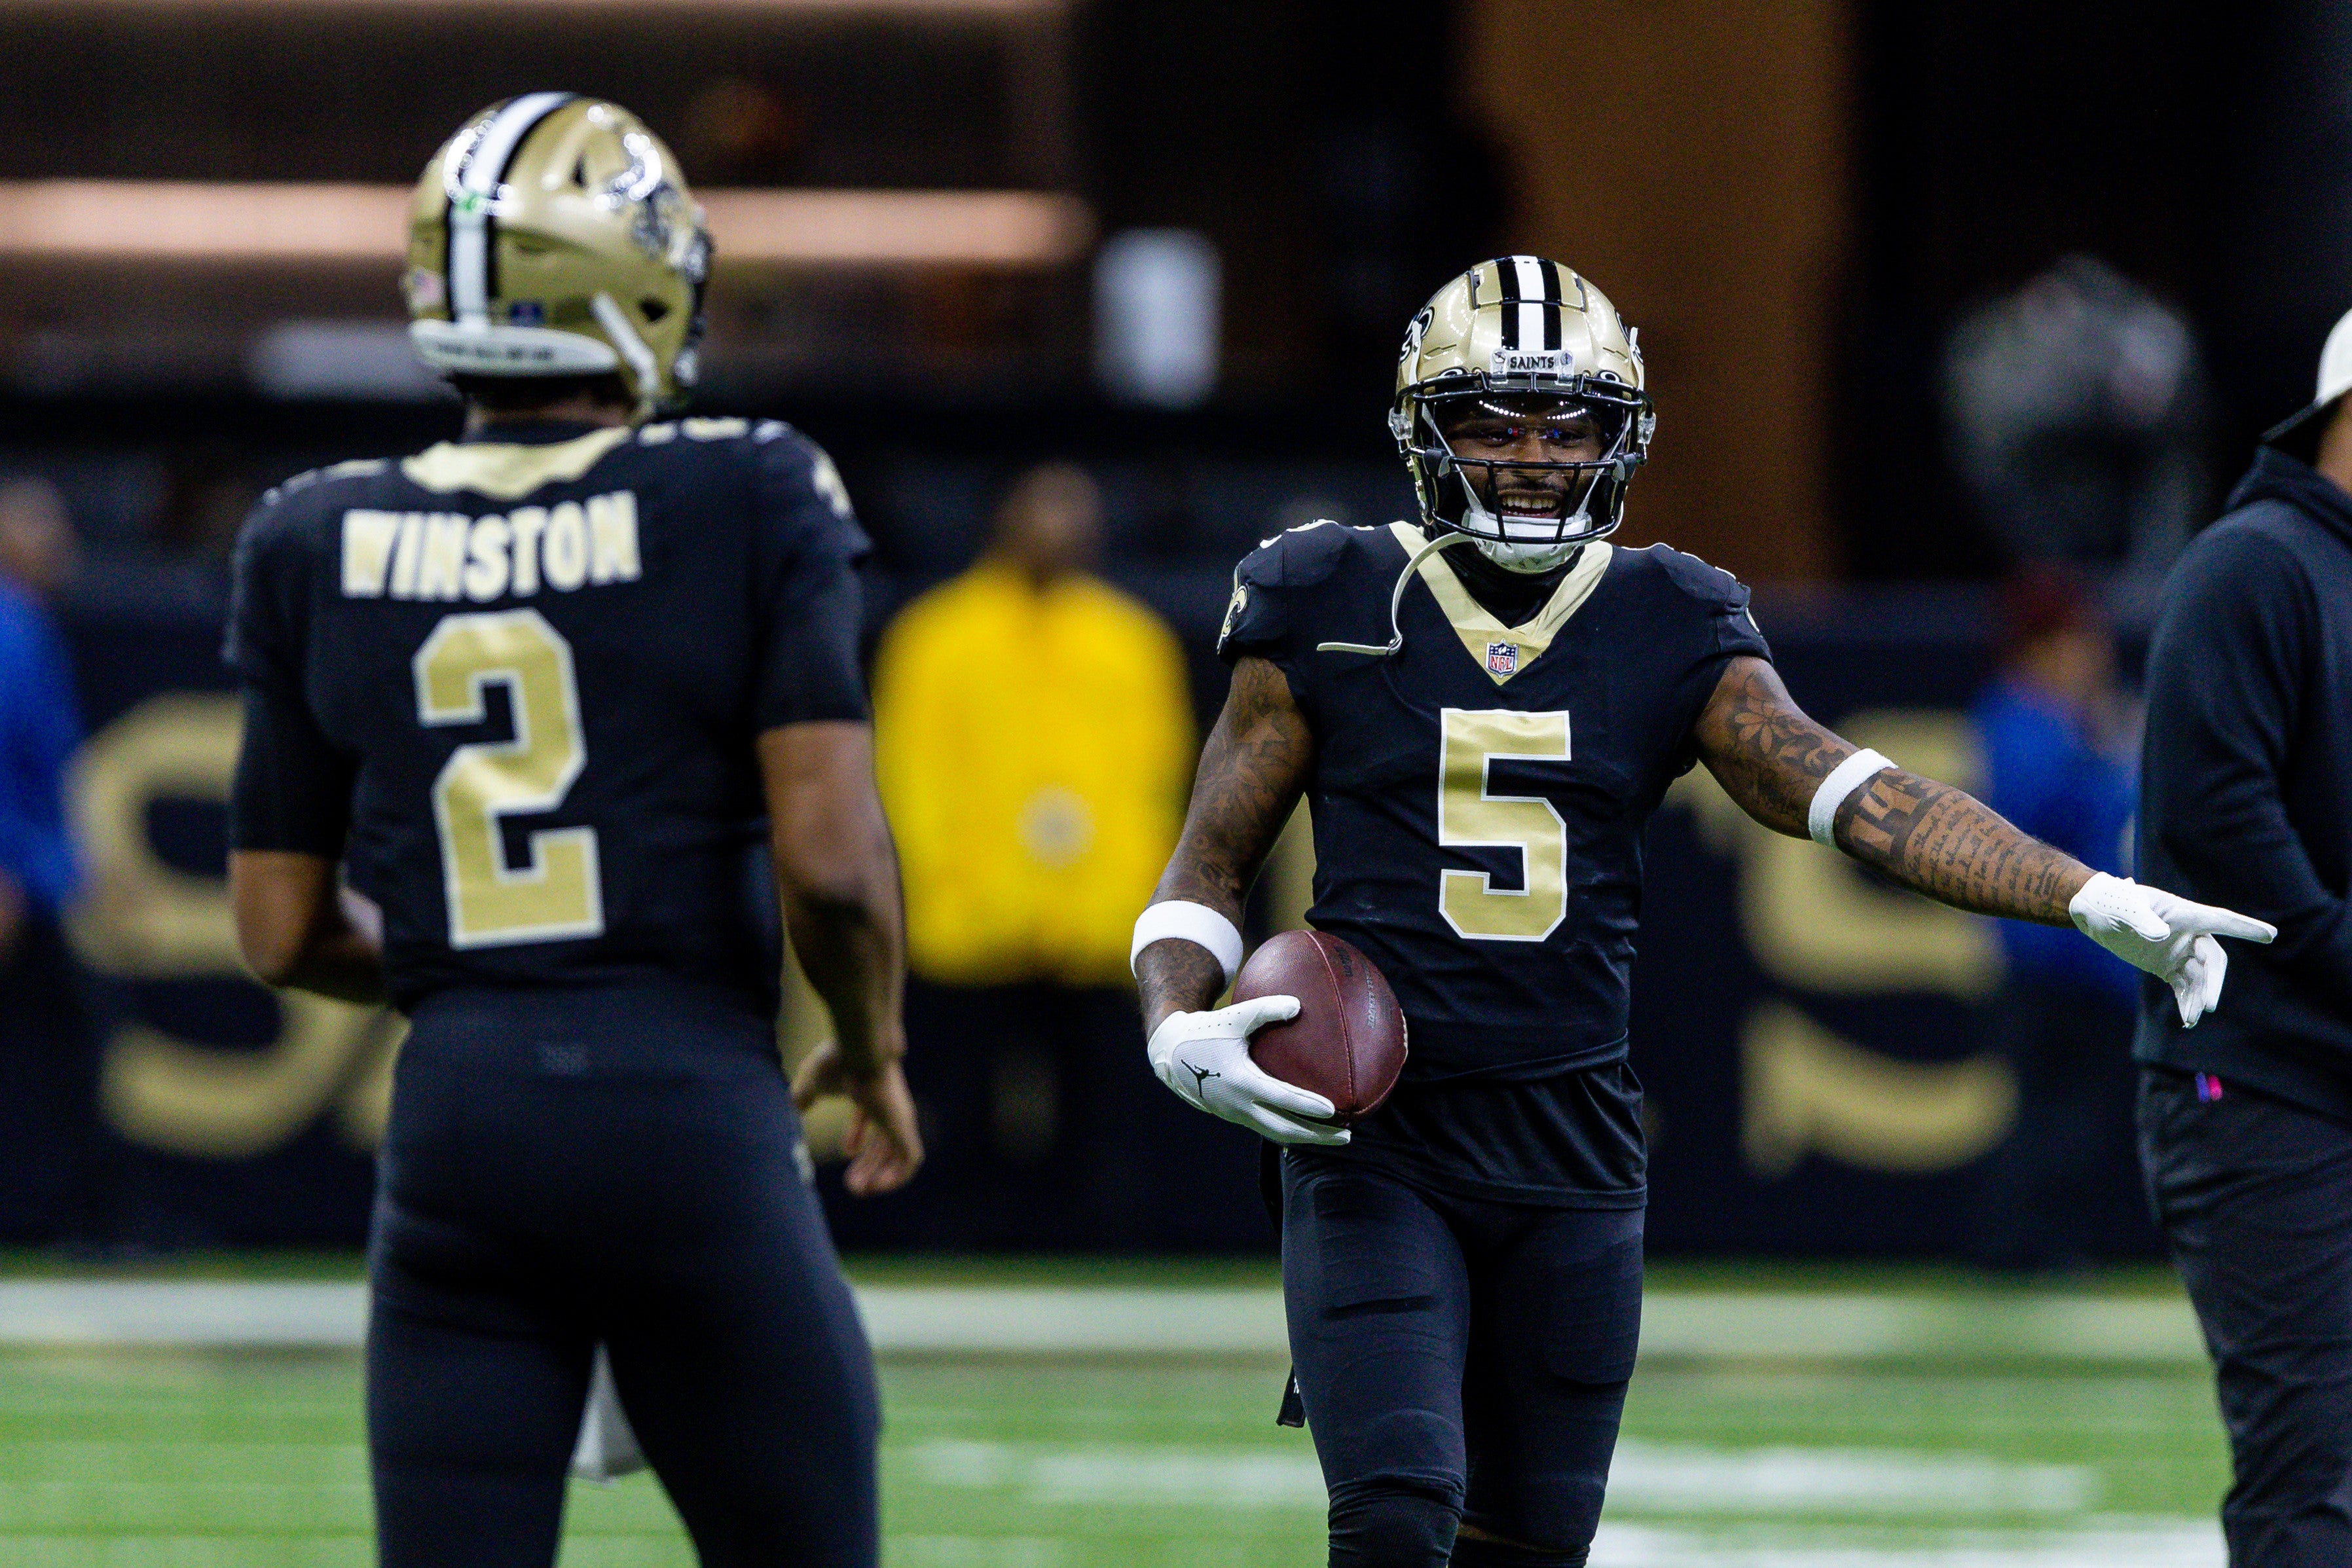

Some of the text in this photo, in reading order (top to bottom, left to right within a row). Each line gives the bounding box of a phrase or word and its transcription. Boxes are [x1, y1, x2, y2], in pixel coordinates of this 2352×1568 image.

[1510, 356, 1555, 369] SAINTS
[341, 490, 642, 602] WINSTON
[1490, 656, 1512, 670] NFL
[411, 607, 606, 951] 2
[1439, 708, 1571, 943] 5
